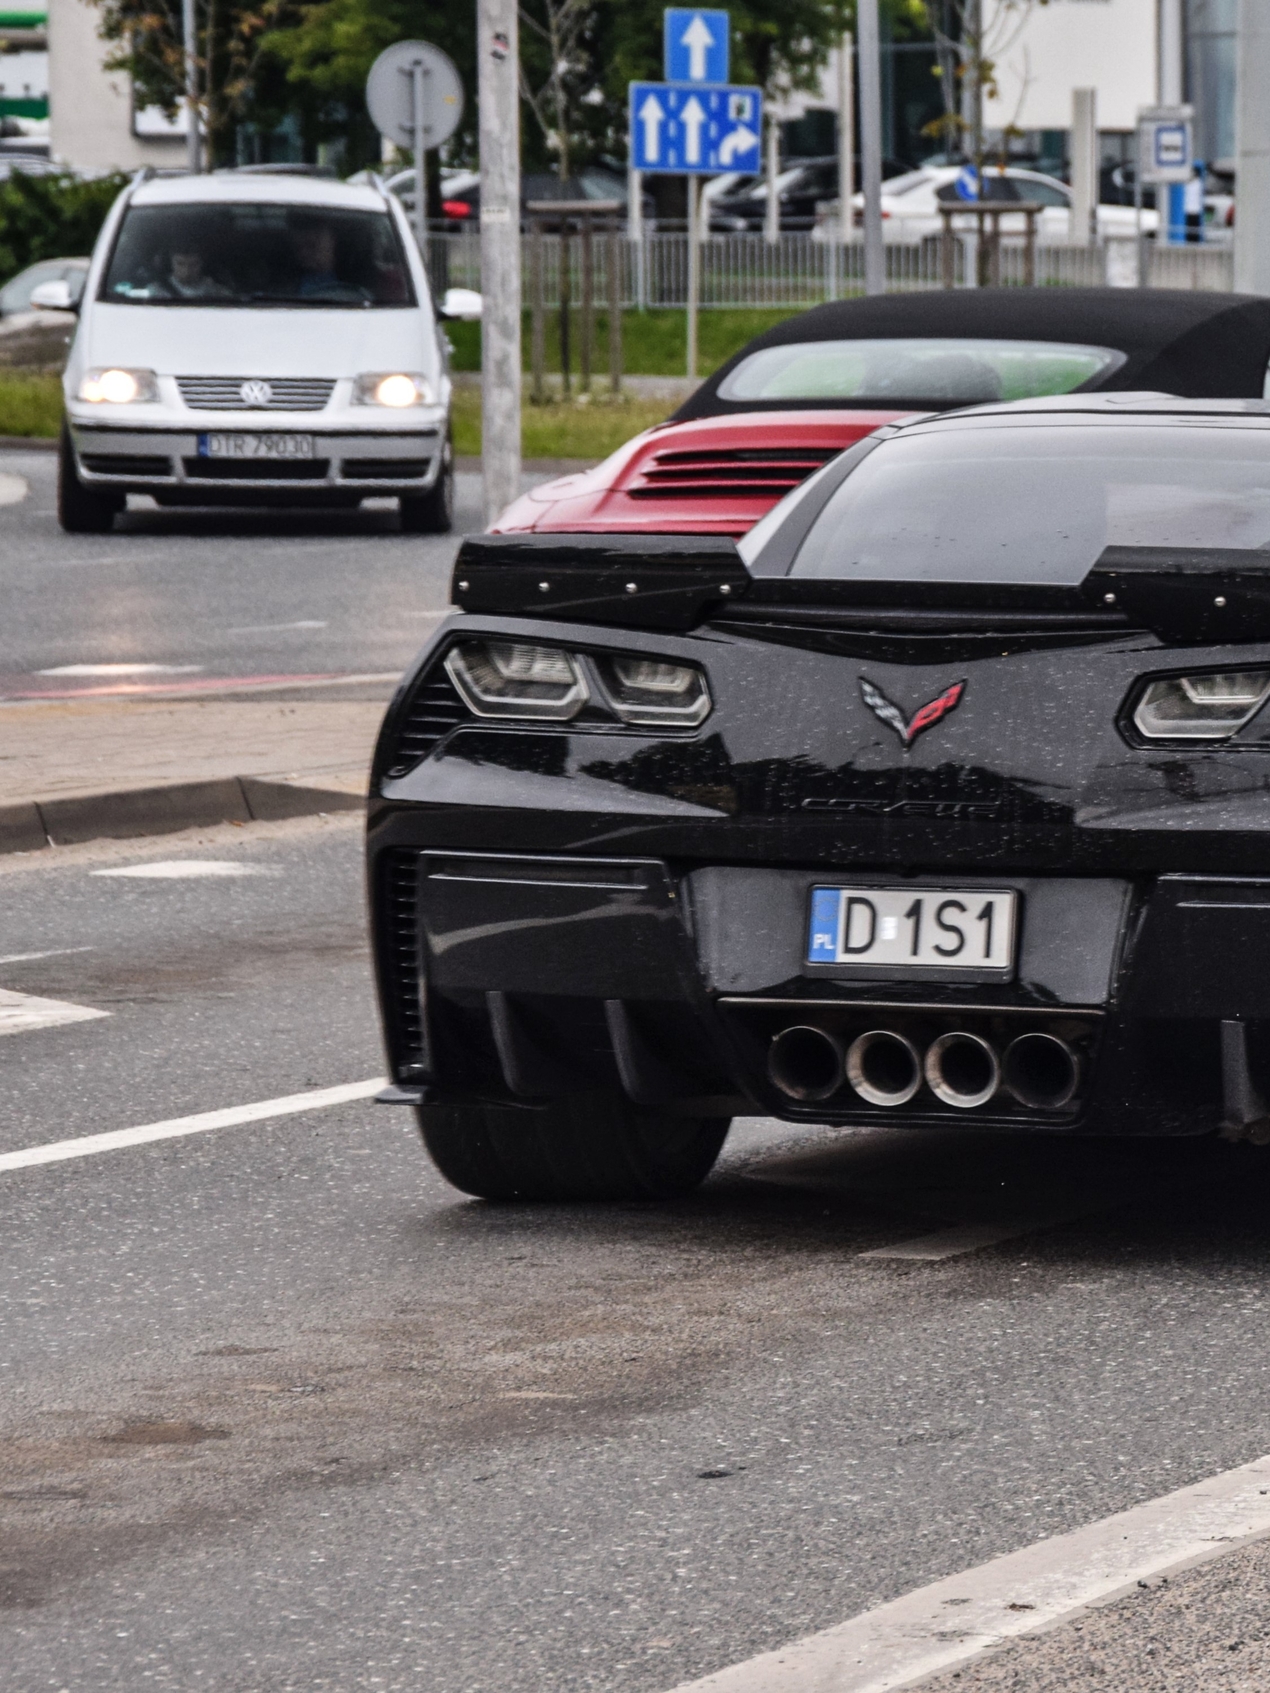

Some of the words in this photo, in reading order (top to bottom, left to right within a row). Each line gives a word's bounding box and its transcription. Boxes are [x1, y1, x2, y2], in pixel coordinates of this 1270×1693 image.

[209, 433, 245, 458] DTR
[842, 896, 877, 955] D
[904, 898, 995, 959] 1S1
[812, 933, 836, 950] PL
